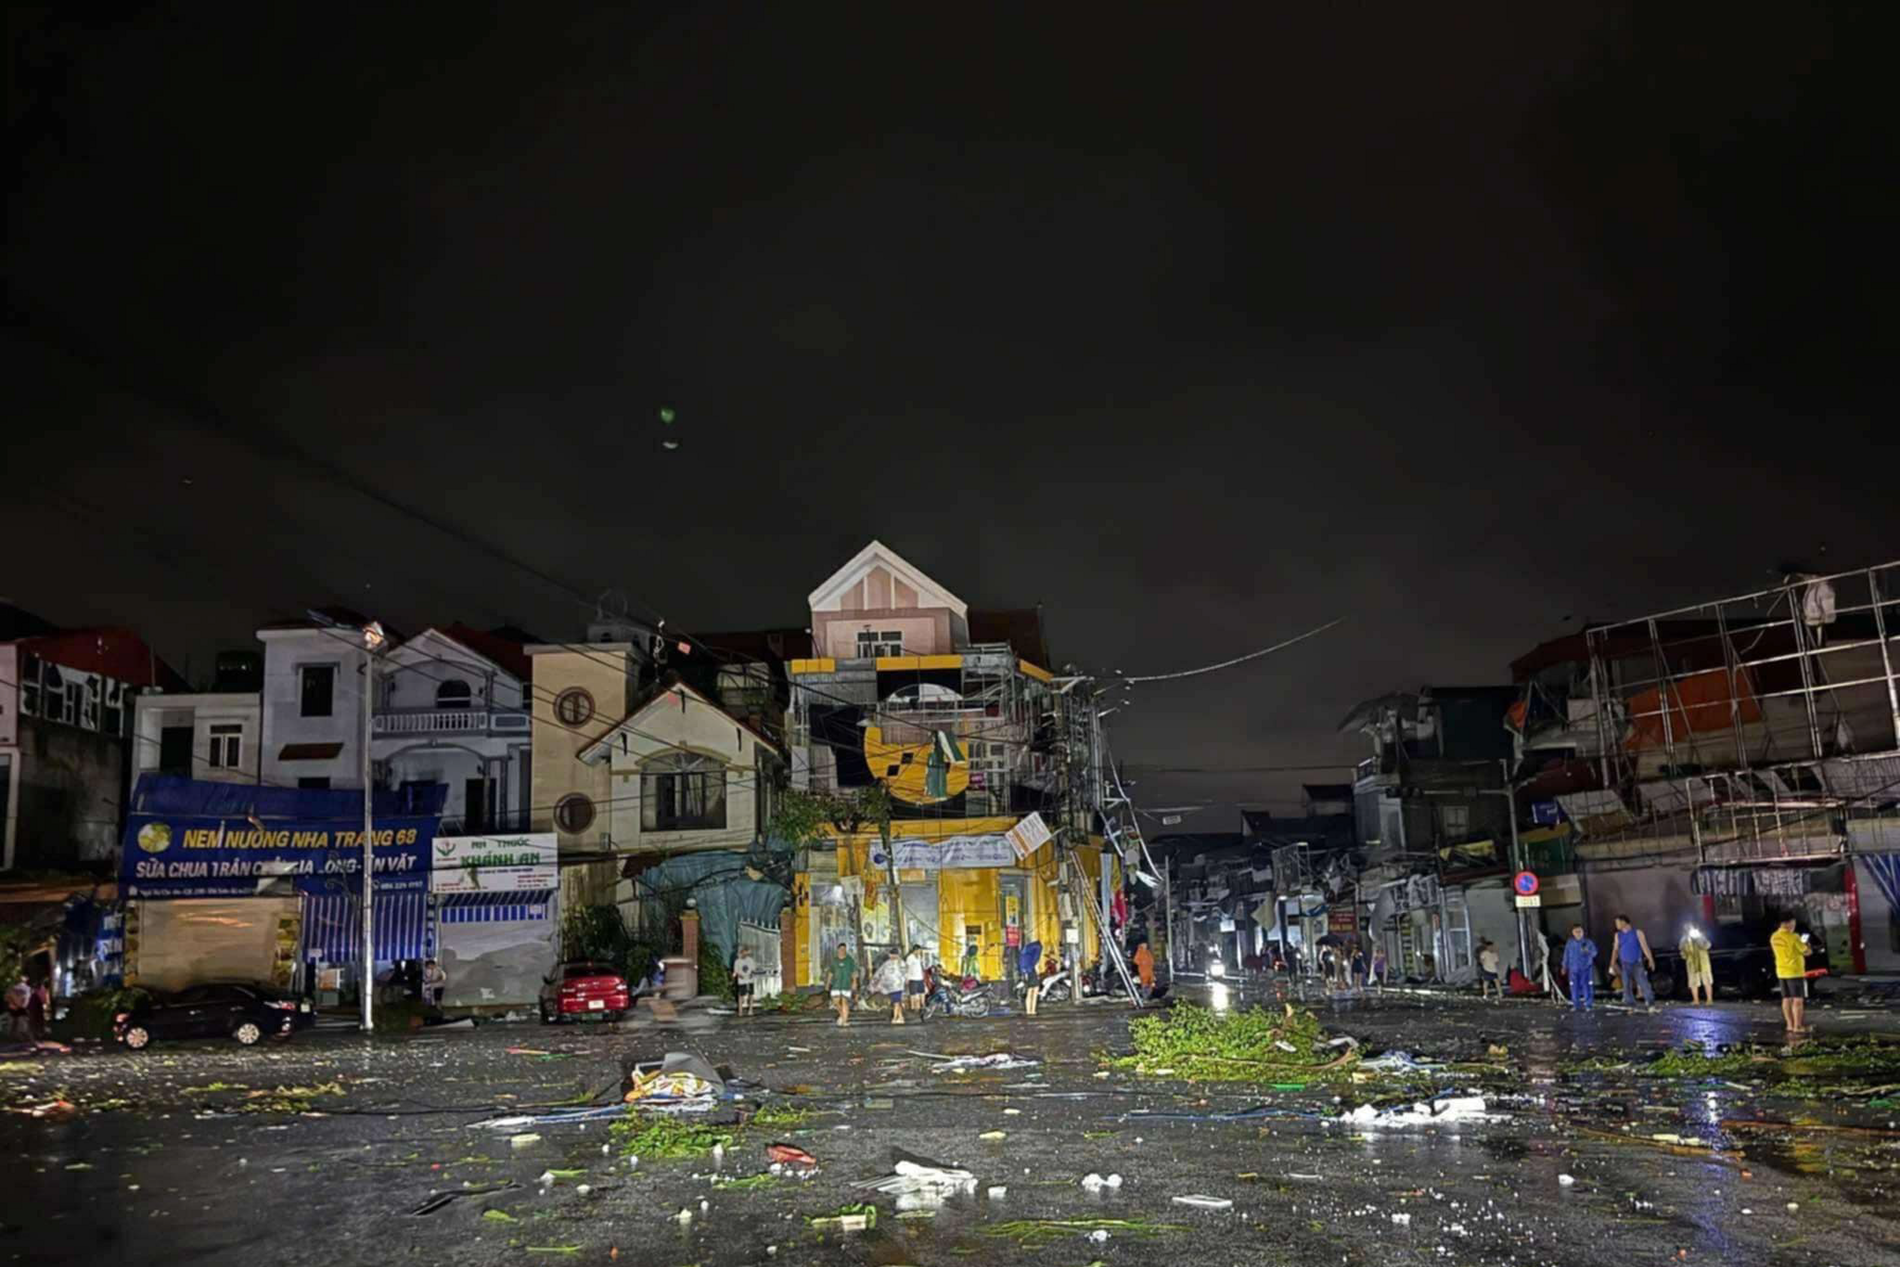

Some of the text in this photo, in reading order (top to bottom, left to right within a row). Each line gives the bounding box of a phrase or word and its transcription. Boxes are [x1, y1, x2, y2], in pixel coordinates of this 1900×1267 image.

[183, 829, 224, 848] NEM
[291, 830, 328, 848] NHA
[334, 829, 394, 848] TRANG
[395, 827, 418, 846] 68
[168, 861, 208, 878] CHUA
[387, 852, 418, 875] VẶT
[460, 850, 540, 867] KHÁNH AN
